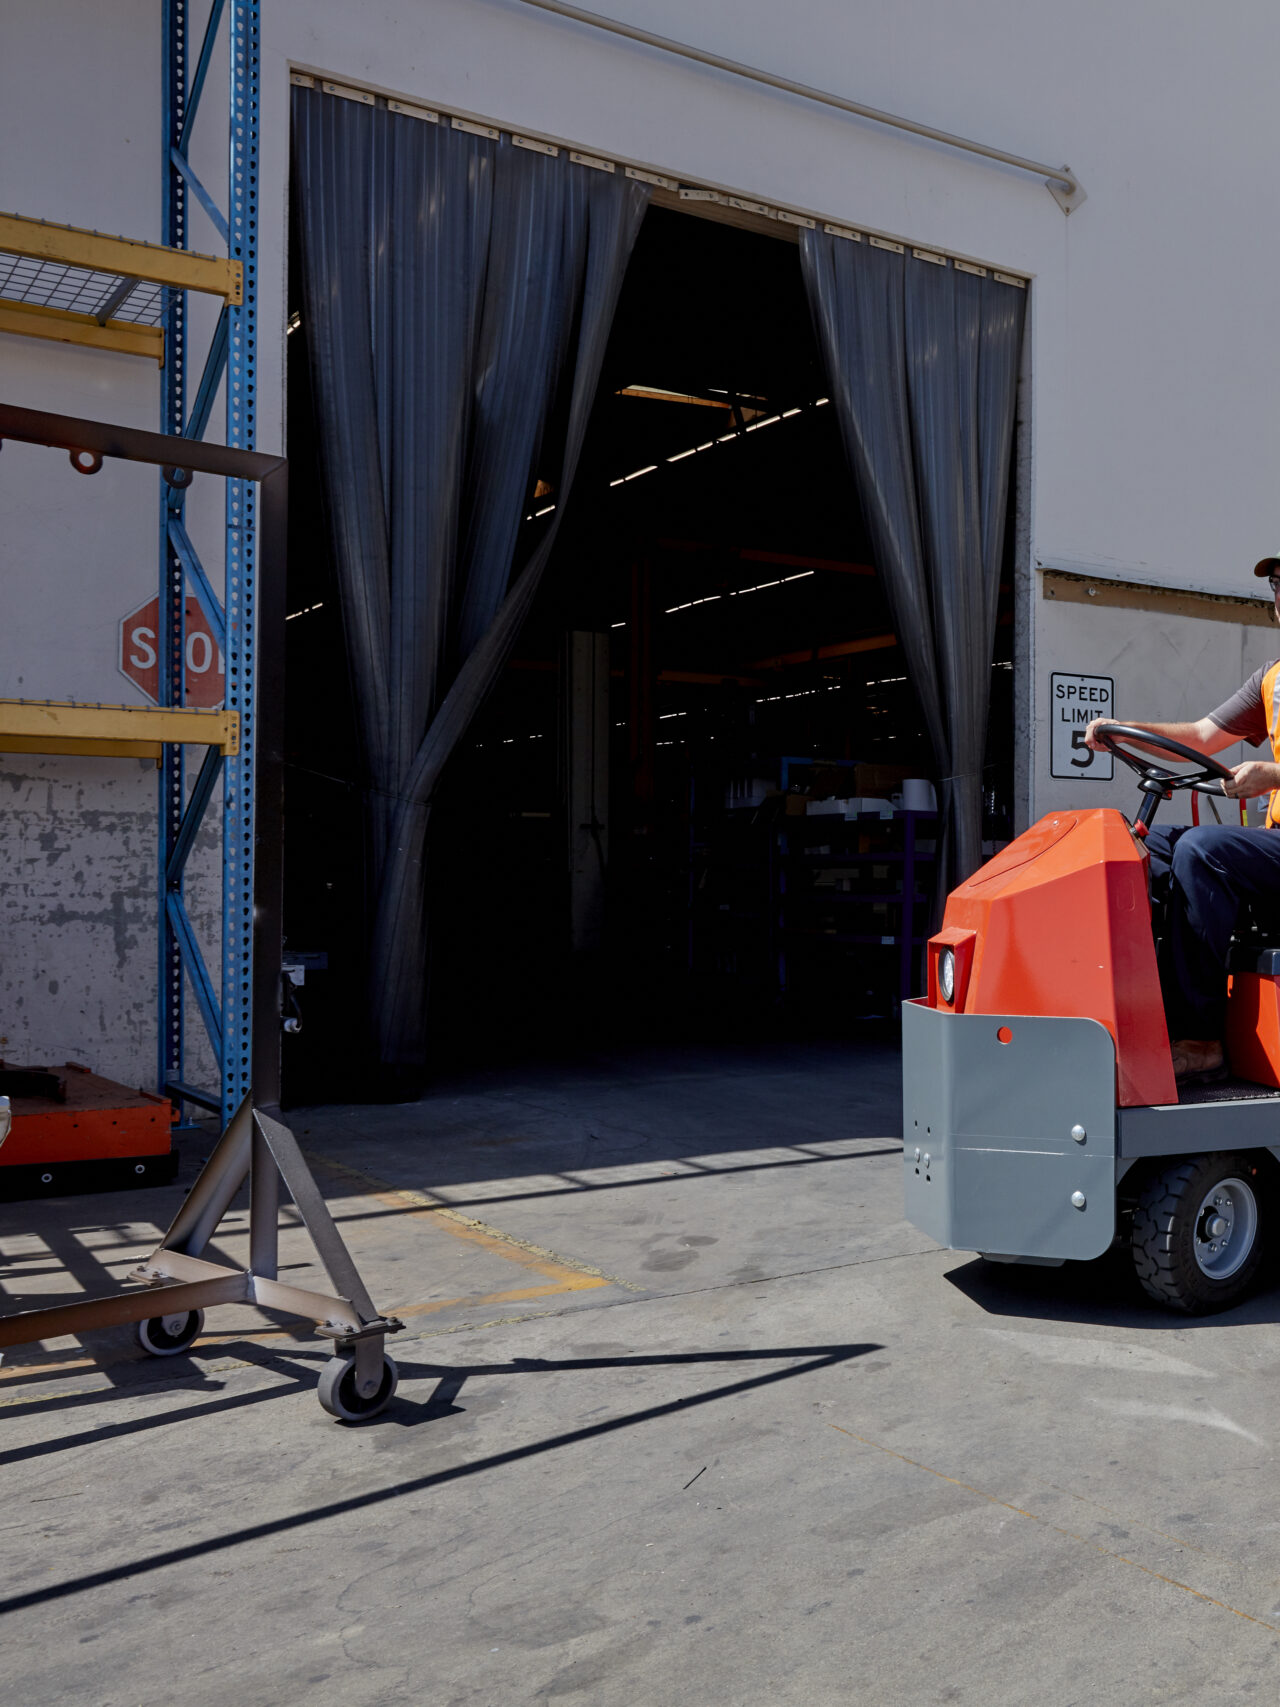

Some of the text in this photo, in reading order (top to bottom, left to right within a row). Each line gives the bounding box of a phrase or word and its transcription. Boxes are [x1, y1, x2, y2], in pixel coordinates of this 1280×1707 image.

[130, 626, 226, 674] SO
[1056, 684, 1109, 703] SPEED
[1071, 731, 1094, 767] 5
